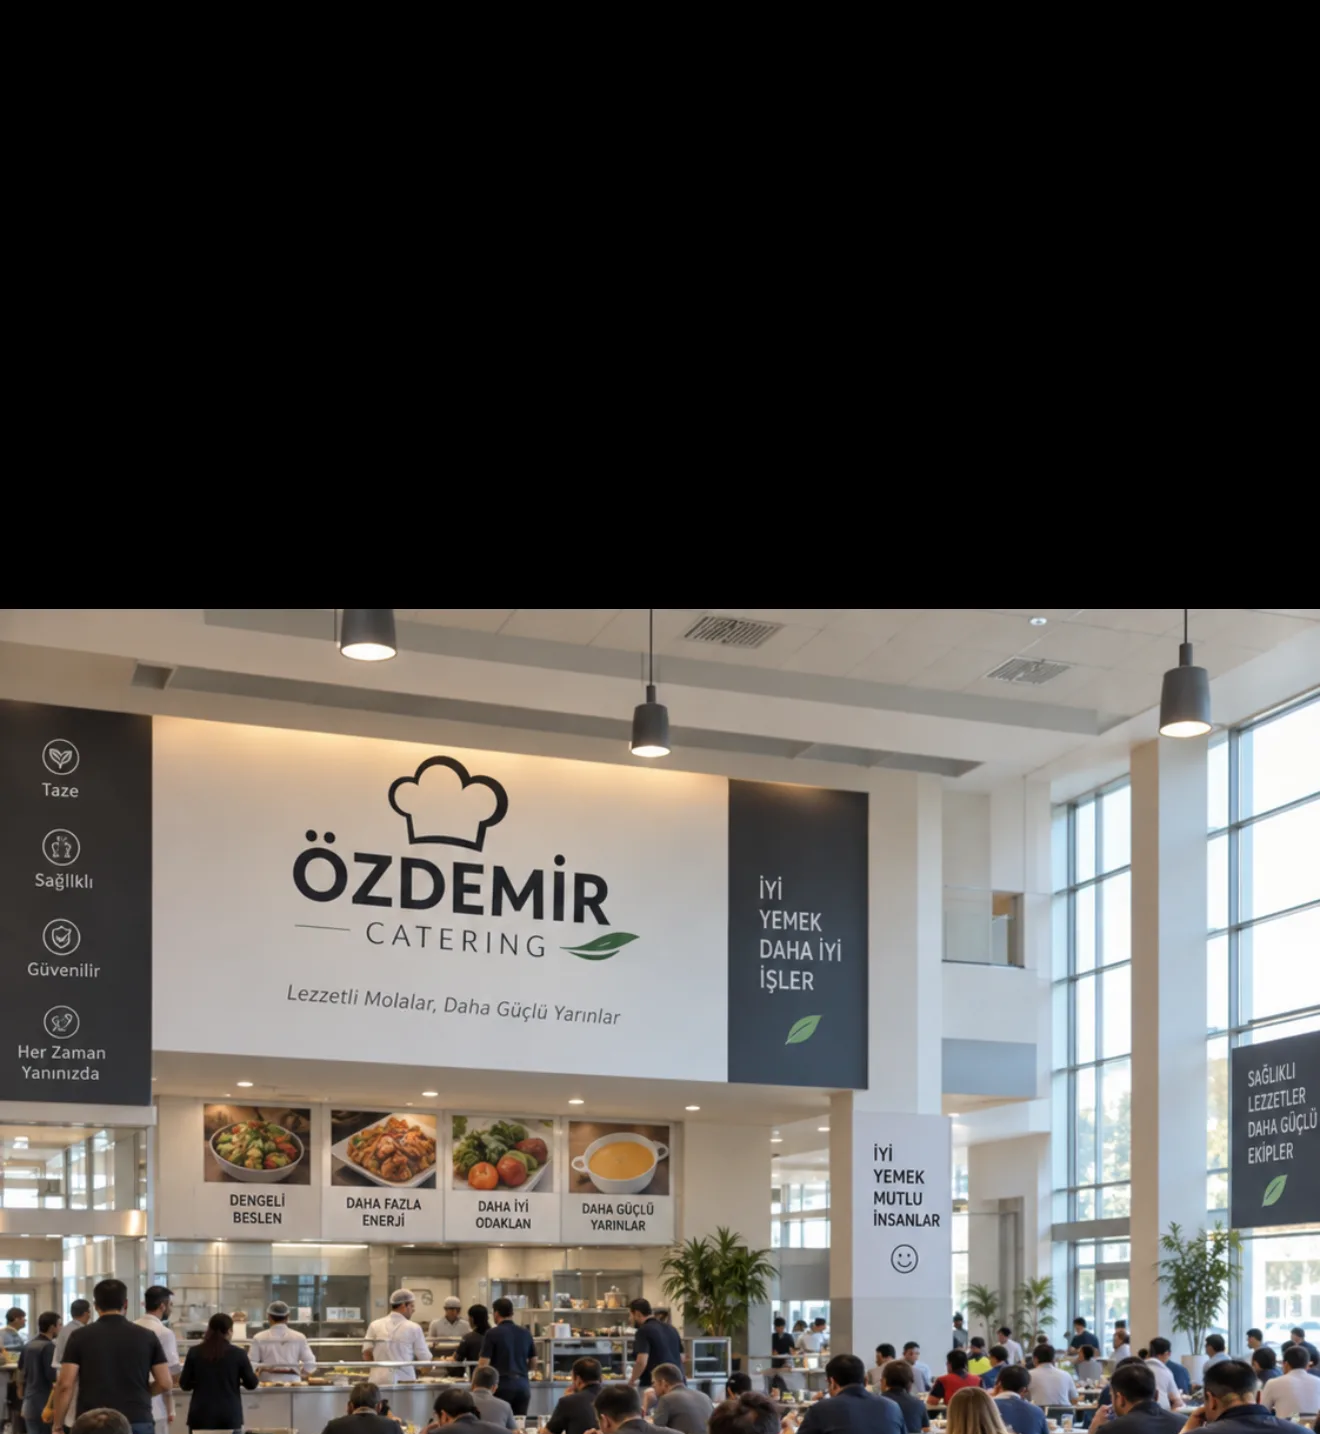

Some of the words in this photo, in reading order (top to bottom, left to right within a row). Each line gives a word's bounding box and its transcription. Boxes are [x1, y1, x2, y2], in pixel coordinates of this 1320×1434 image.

[41, 782, 79, 798] Taze
[293, 829, 610, 925] ÖZDEMİR
[760, 875, 781, 900] İYİ
[759, 909, 823, 933] YEMEK
[366, 922, 545, 957] CATERING
[759, 938, 814, 961] DAHA
[819, 937, 842, 962] İYİ
[27, 961, 101, 978] Güvenilir
[761, 965, 813, 993] İŞLER
[287, 984, 359, 1005] Lezzetli
[364, 990, 437, 1014] Molalar,
[443, 996, 491, 1016] Daha
[496, 1000, 548, 1023] Güçlü
[554, 1005, 621, 1025] Yarınlar
[18, 1044, 47, 1059] Her
[51, 1045, 106, 1060] Zaman
[21, 1065, 100, 1081] Yanınızda
[1247, 1062, 1296, 1087] SAĞLIKLI
[1247, 1087, 1306, 1112] LEZZETLER
[1248, 1119, 1278, 1137] DAHA
[1281, 1107, 1318, 1135] GÜÇLÜ
[873, 1143, 893, 1162] İYİ
[1248, 1142, 1293, 1164] EKİPLER
[873, 1168, 925, 1185] YEMEK
[229, 1192, 286, 1208] DENGELİ
[346, 1196, 382, 1210] DAHA
[384, 1197, 422, 1212] FAZLA
[478, 1200, 512, 1213] DAHA
[514, 1198, 529, 1213] İYİ
[873, 1190, 923, 1206] MUTLU
[233, 1211, 282, 1225] BESLEN
[582, 1202, 614, 1215] DAHA
[616, 1201, 655, 1218] GÜÇLÜ
[873, 1208, 941, 1228] İNSANLAR
[362, 1212, 405, 1228] ENERJİ
[475, 1216, 532, 1230] ODAKLAN
[590, 1218, 646, 1232] YARINLAR
